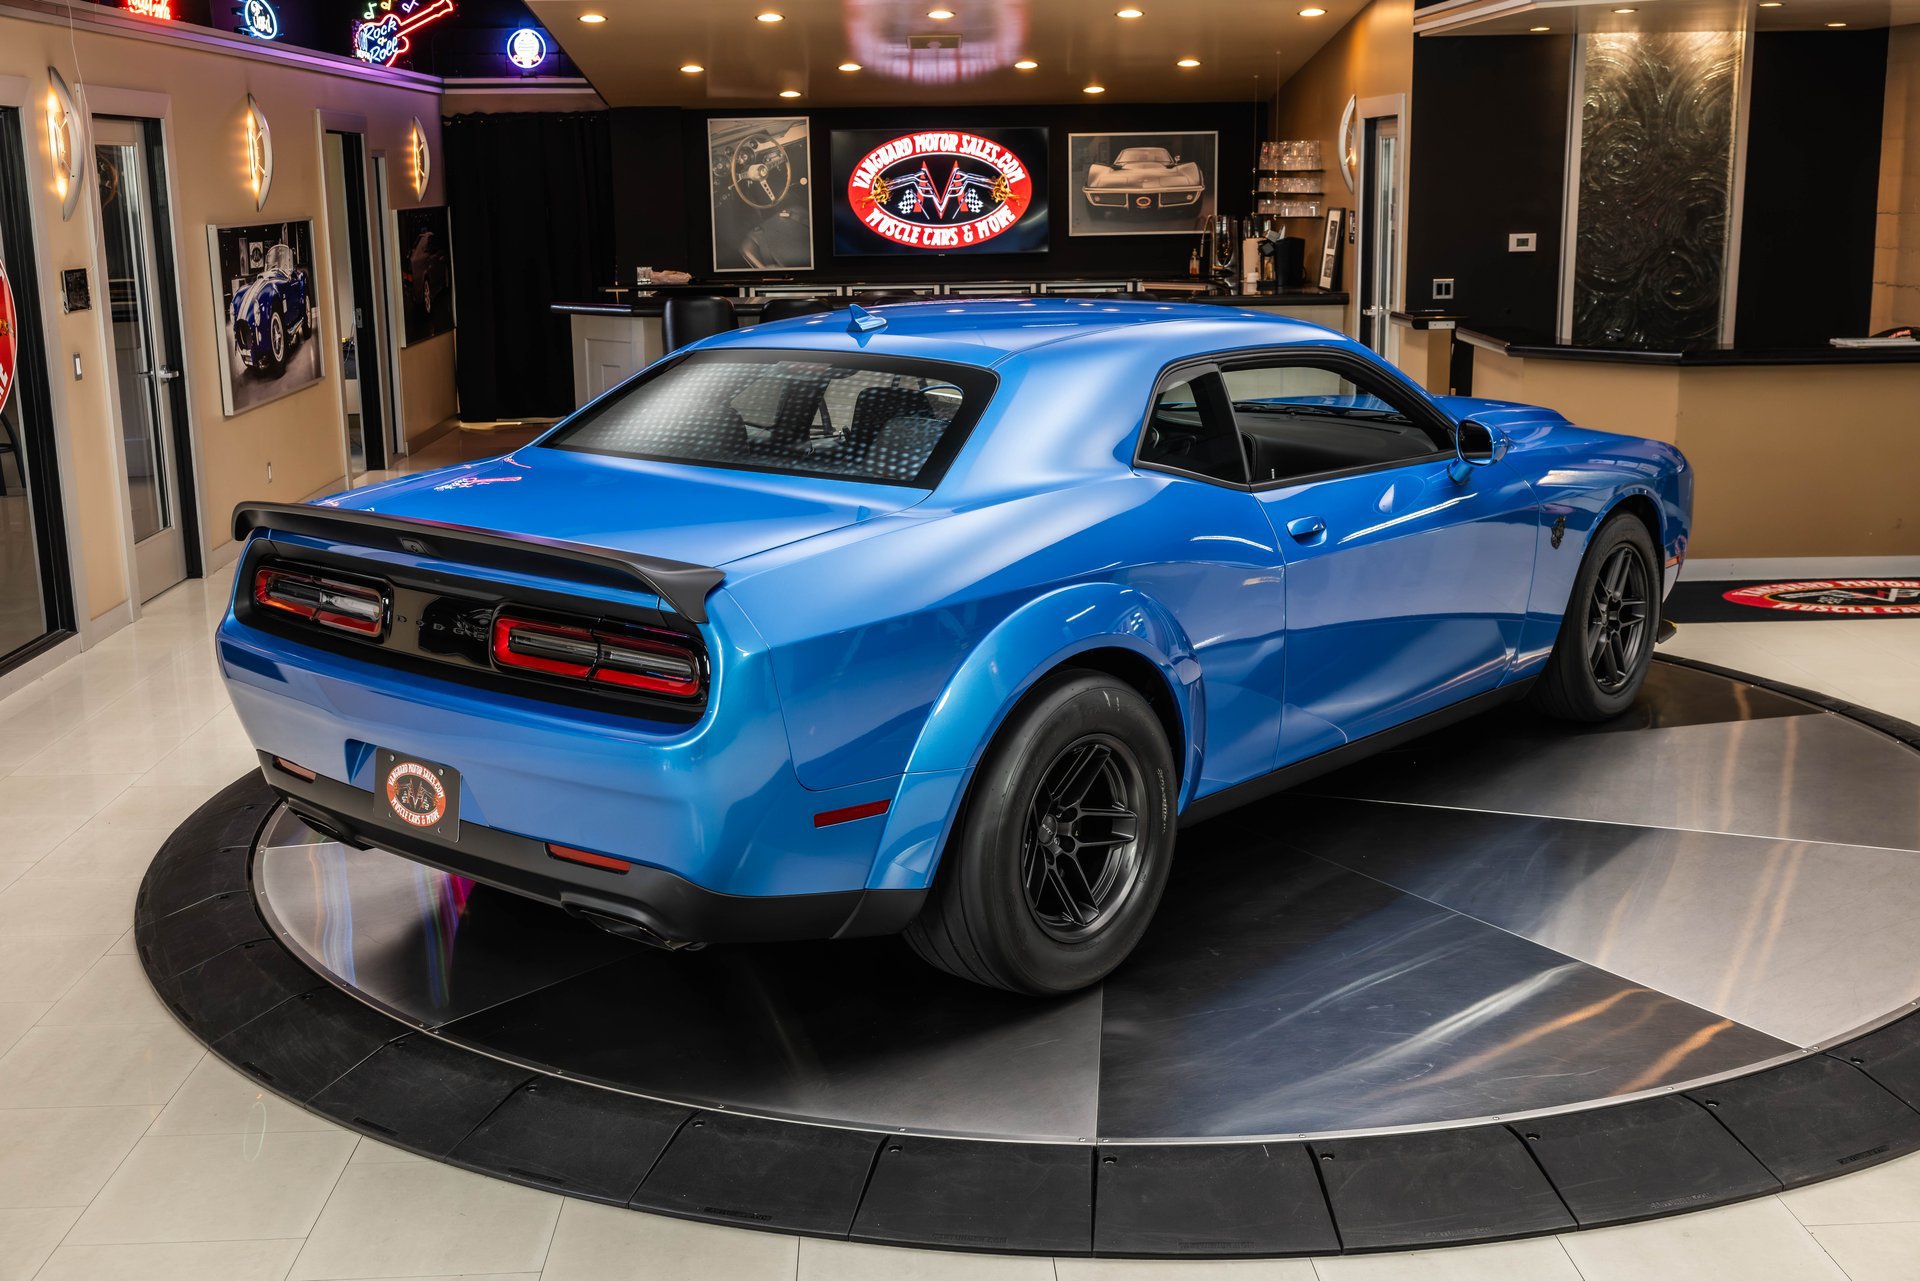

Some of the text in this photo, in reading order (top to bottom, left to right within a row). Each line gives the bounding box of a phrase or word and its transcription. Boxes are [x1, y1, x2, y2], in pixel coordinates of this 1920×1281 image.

[364, 16, 398, 41] Rock
[369, 36, 399, 63] Roll
[852, 133, 1026, 189] VANGUARD MOTOR SALES.COM
[865, 204, 1017, 246] MUSCLE CARS & MORE
[1731, 580, 1920, 597] VANGUARD MOTOR
[1772, 603, 1877, 613] MUSCLE
[396, 612, 486, 642] DODGE
[388, 764, 444, 798] VANGUARD MOTOR SALES.COM
[391, 797, 408, 820] MUSCLE
[408, 813, 420, 825] CARS
[426, 809, 439, 824] MORE
